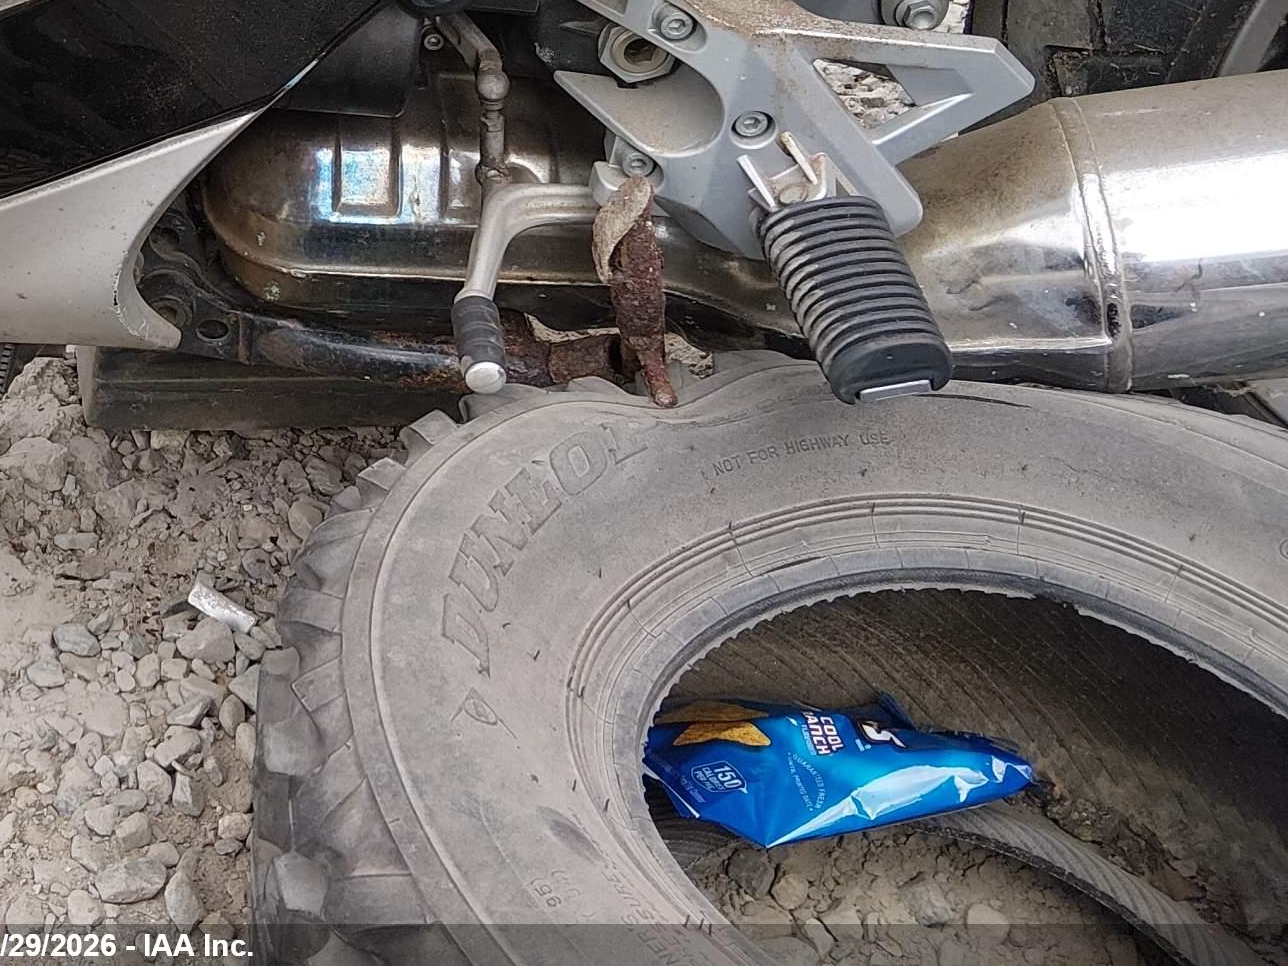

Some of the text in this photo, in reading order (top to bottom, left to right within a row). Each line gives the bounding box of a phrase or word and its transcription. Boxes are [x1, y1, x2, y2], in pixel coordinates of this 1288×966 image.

[713, 430, 891, 476] NOT FOR HIGHWAY USE
[819, 716, 845, 752] COOL
[713, 765, 742, 789] 150
